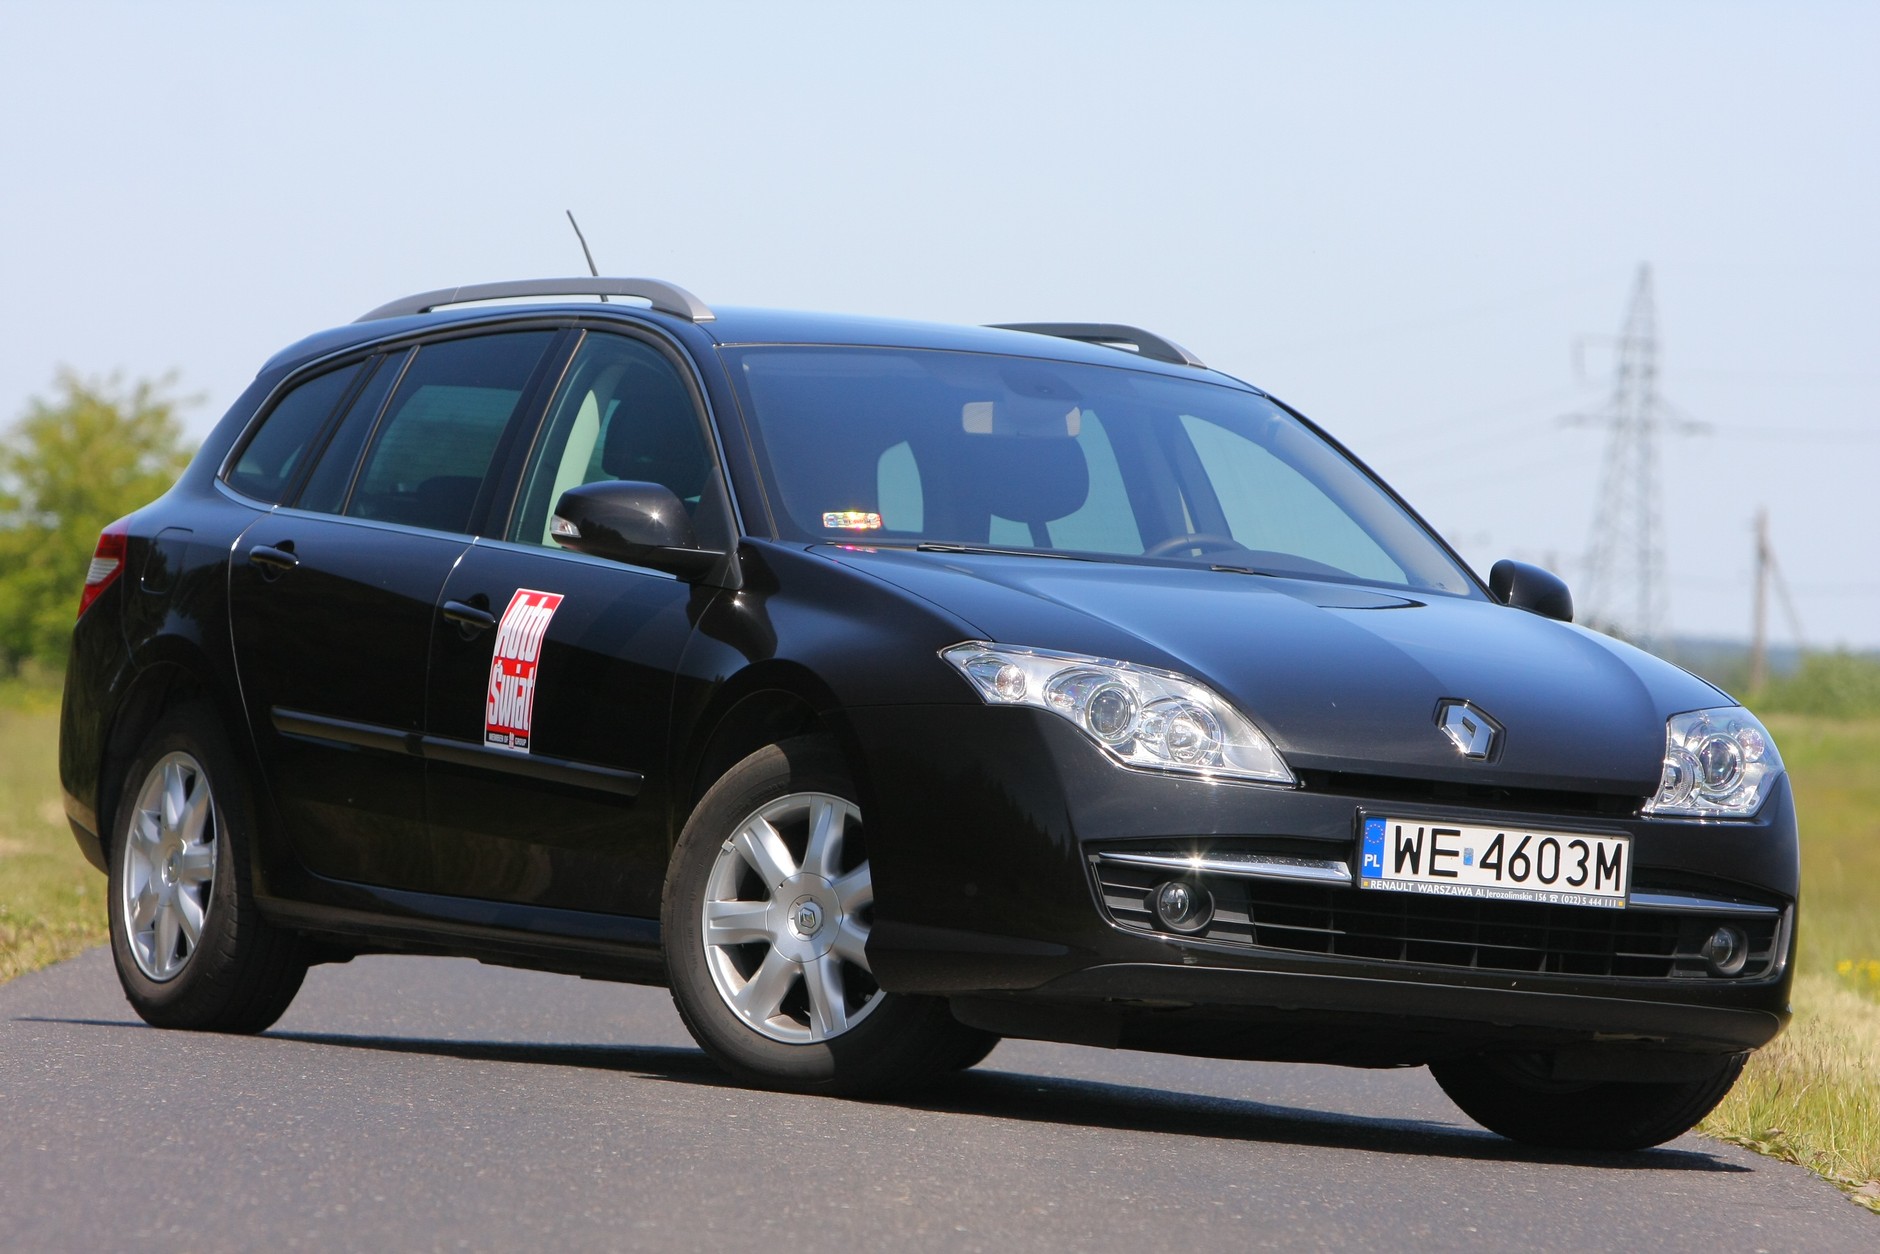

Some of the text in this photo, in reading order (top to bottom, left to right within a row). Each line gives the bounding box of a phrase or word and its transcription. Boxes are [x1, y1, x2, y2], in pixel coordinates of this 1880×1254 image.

[495, 593, 553, 662] Auto
[488, 659, 535, 730] Świat
[1364, 854, 1380, 868] PL
[1394, 825, 1623, 892] WE 4603M
[1370, 880, 1414, 892] RENAULT
[1417, 884, 1473, 896] WARSZAWA
[1535, 892, 1547, 902] 156
[1588, 897, 1602, 906] 444
